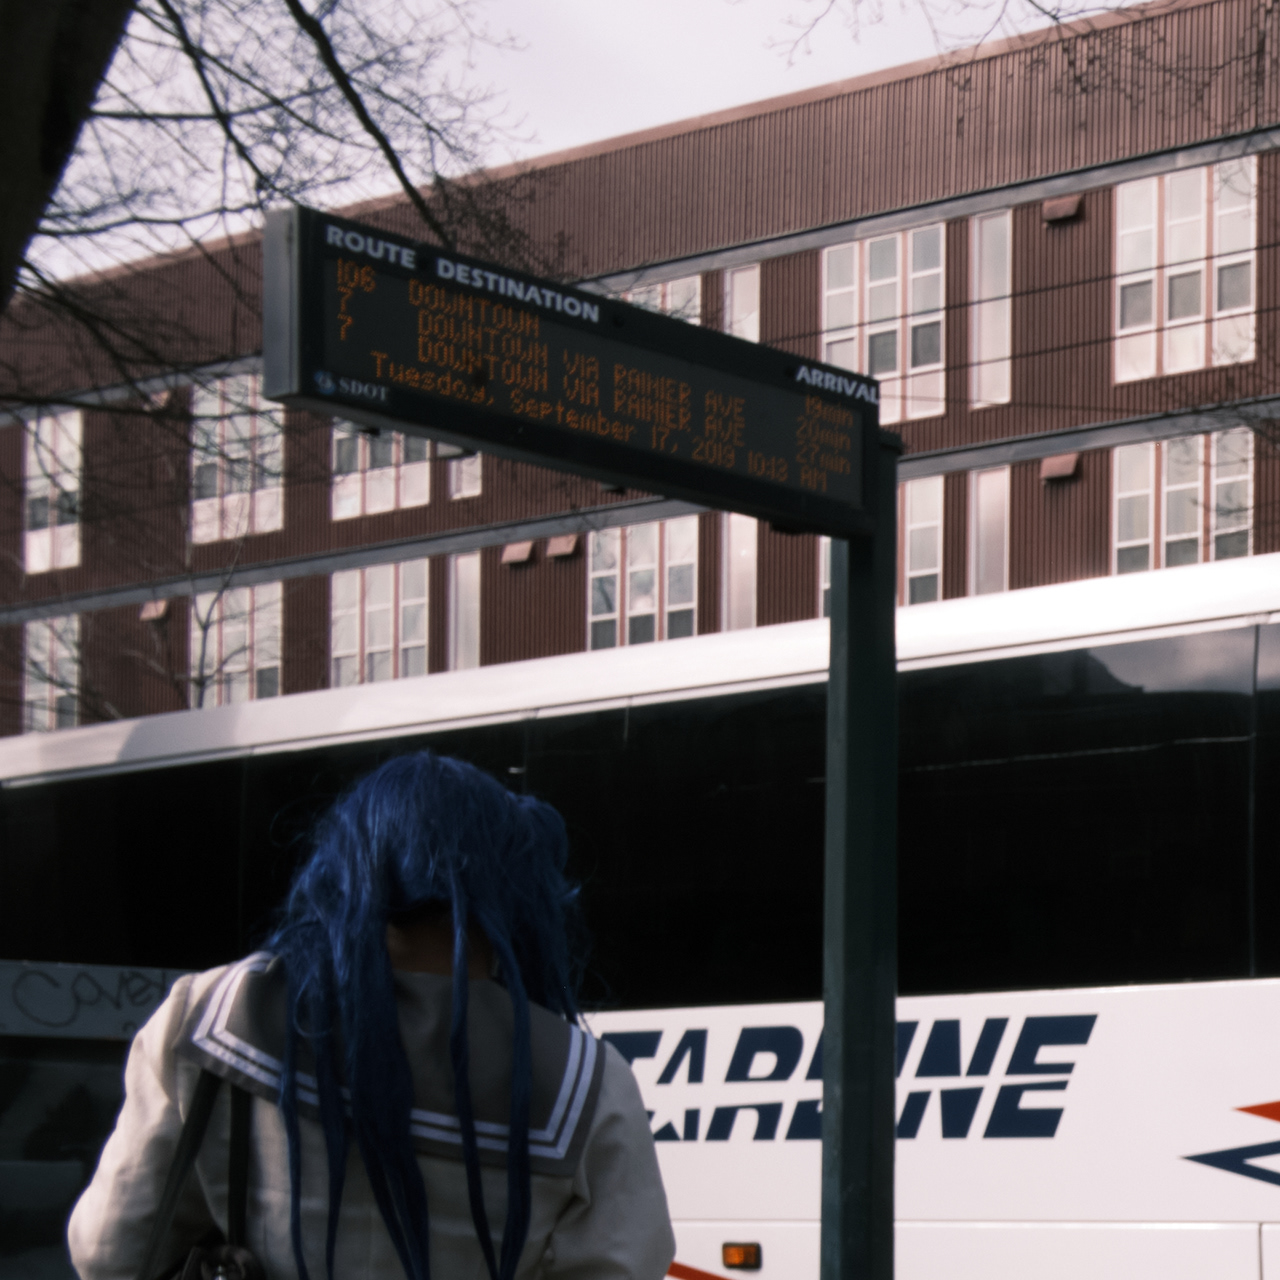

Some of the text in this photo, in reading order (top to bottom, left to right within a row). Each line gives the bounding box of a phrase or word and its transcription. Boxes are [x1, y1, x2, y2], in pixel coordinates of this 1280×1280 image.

[325, 223, 879, 406] ROUTE DESTINATION ARRIVAL
[337, 257, 376, 293] 106
[408, 278, 540, 338] DOWNTOWN
[337, 286, 353, 313] 7
[418, 309, 548, 368] DOWNTOWN
[563, 348, 600, 381] VIA
[614, 363, 691, 407] RAINIER
[705, 389, 746, 422] AVE
[337, 313, 353, 341] 7
[418, 334, 548, 392] DOWNTOWN
[563, 373, 600, 407] VIA
[614, 388, 691, 432] RAINIER
[705, 415, 746, 448] AVE
[339, 376, 390, 401] SDOT
[370, 350, 494, 406] Tuesday,
[510, 388, 636, 442] September
[652, 424, 678, 454] 17,
[800, 465, 827, 493] AM
